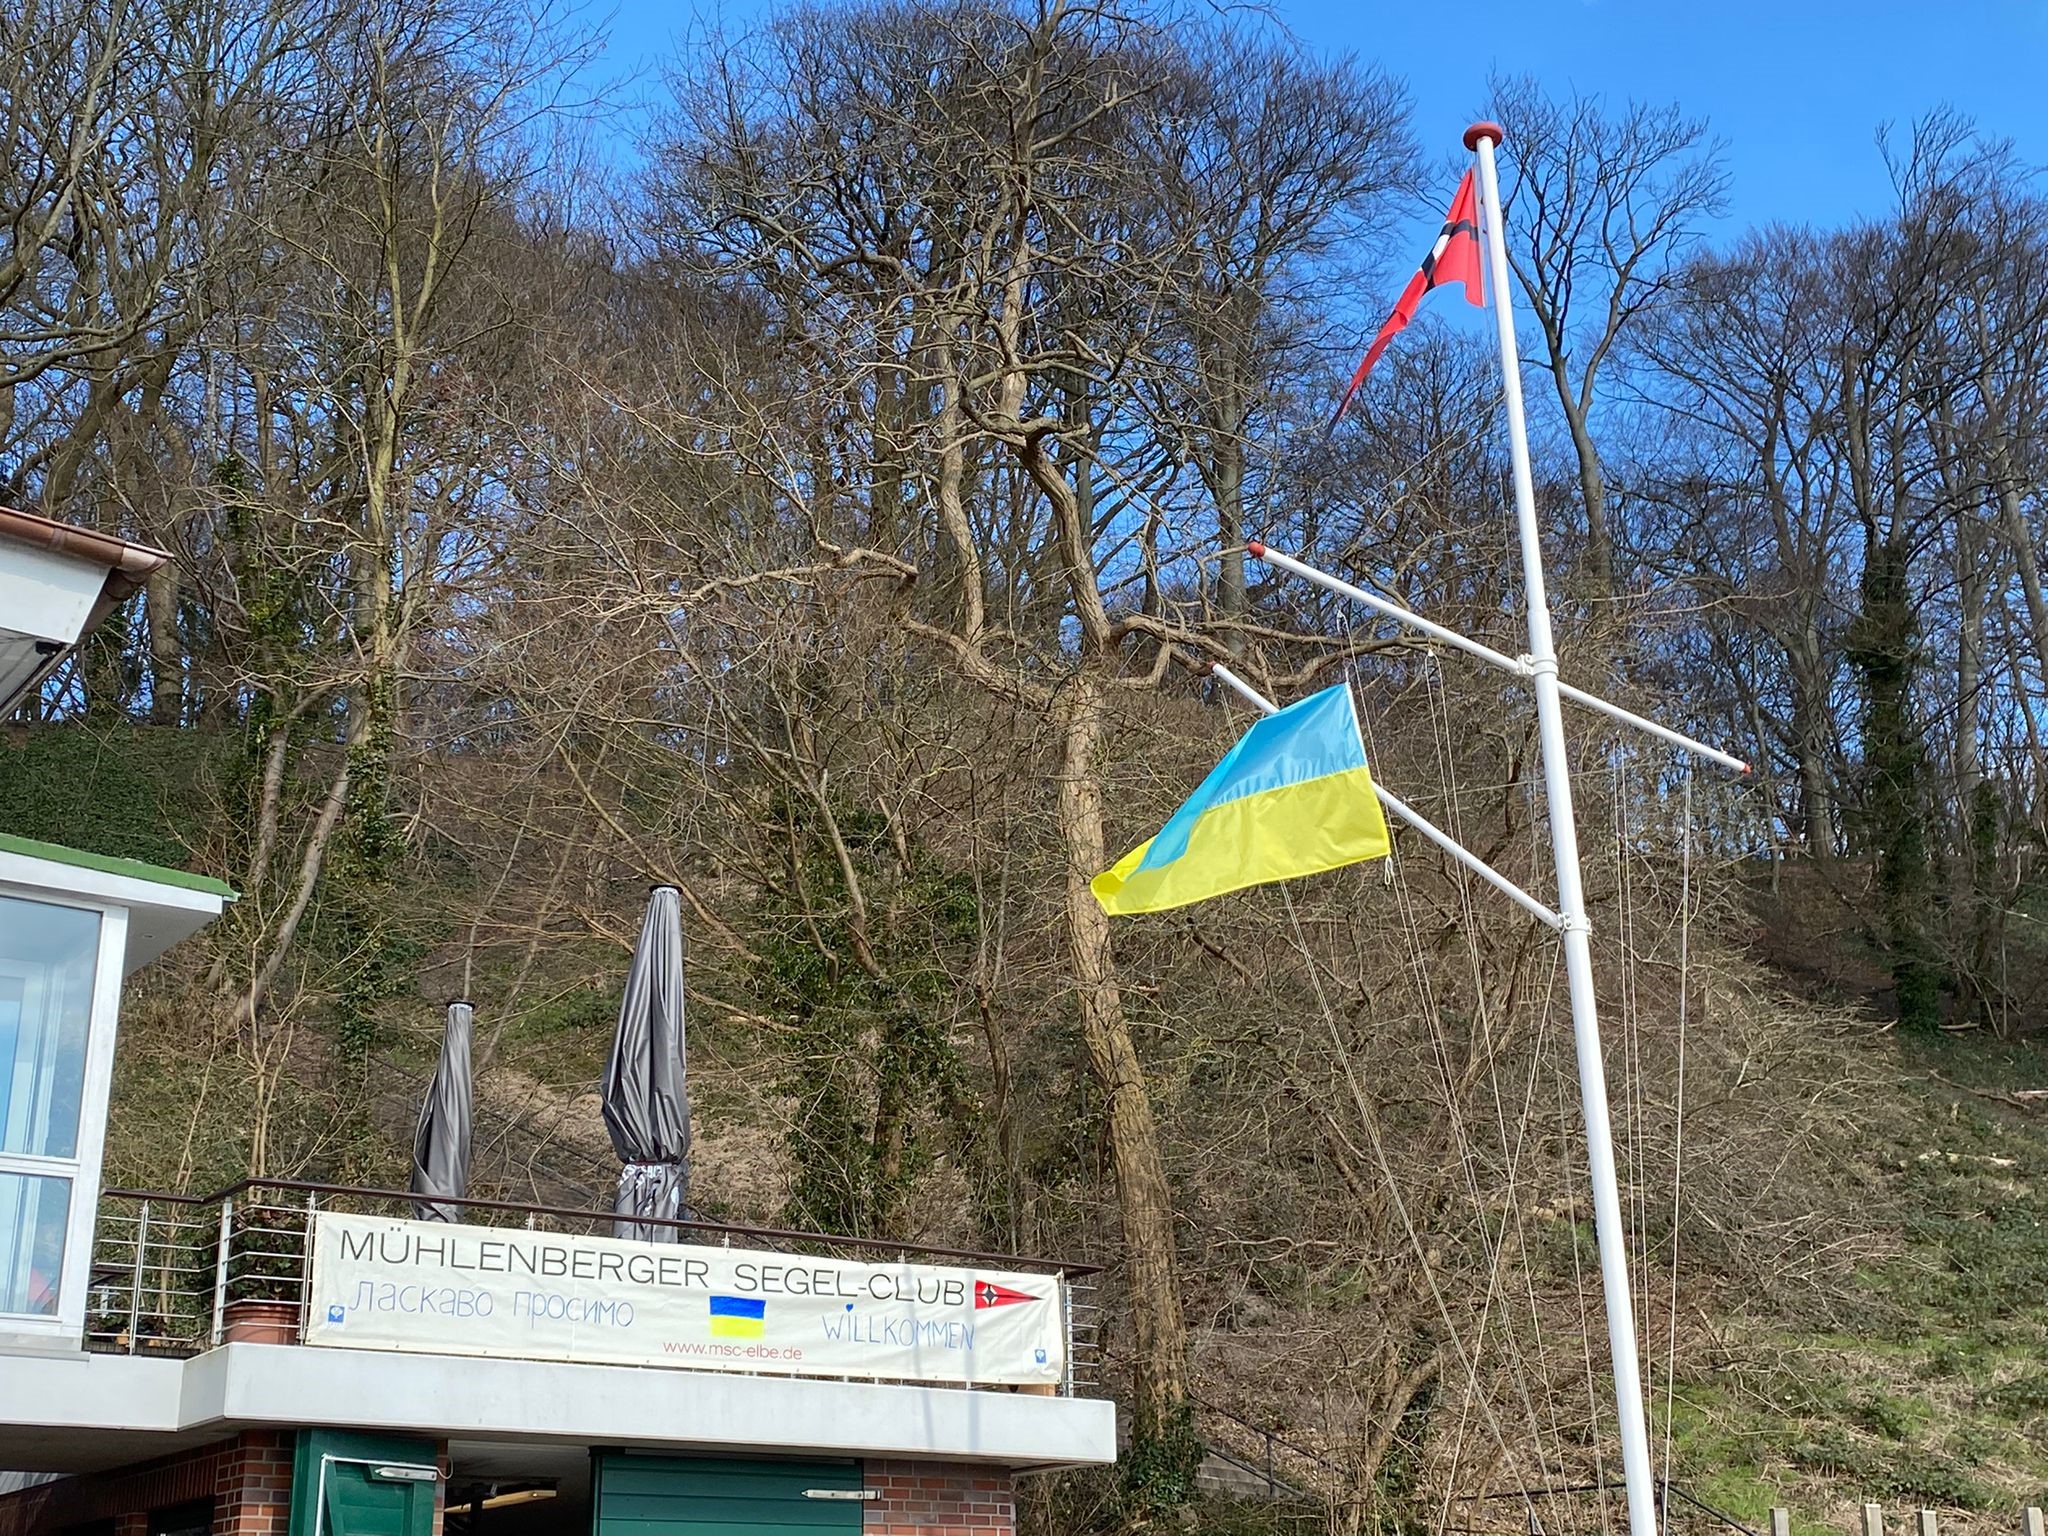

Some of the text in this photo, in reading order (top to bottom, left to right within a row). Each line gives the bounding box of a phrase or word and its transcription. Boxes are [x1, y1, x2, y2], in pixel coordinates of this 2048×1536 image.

[340, 1227, 965, 1306] MÜHLENBERGER SEGEL-CLUB
[513, 1290, 635, 1329] просимо
[662, 1340, 803, 1361] www.msc-elbe.de
